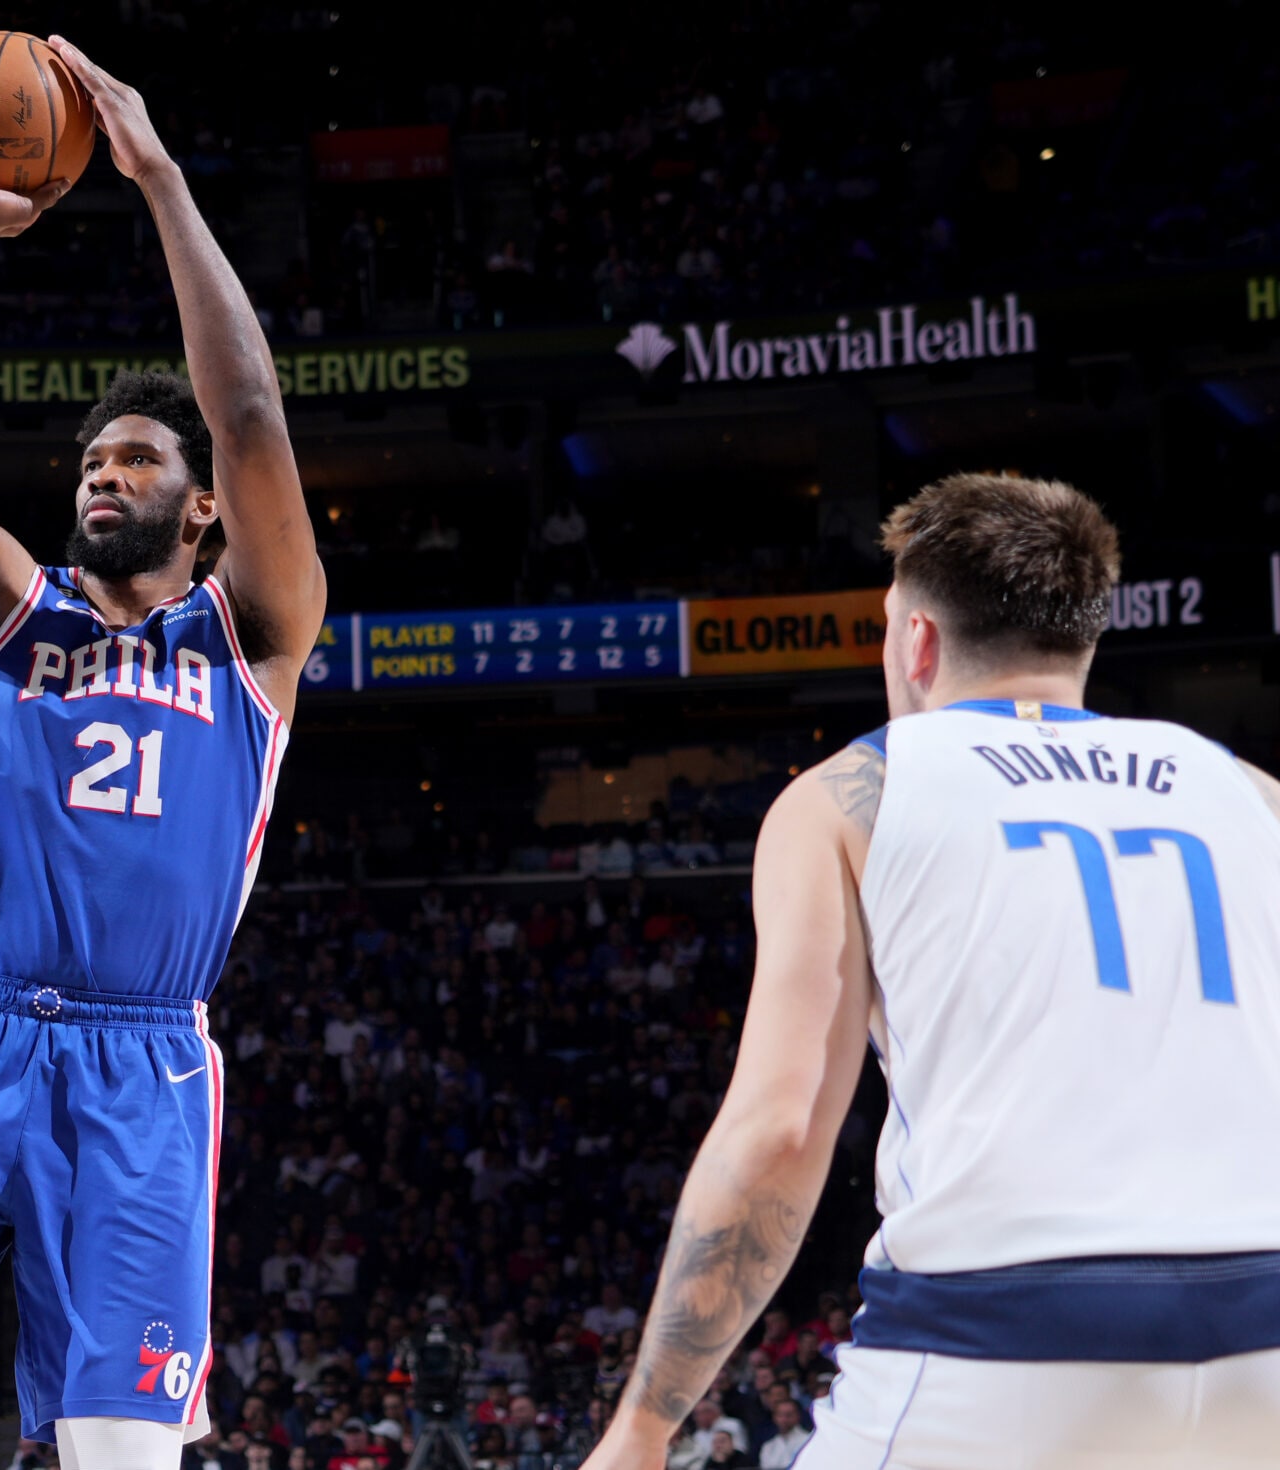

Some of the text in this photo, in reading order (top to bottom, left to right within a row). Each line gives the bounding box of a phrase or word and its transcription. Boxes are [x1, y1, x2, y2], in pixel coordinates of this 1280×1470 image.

[682, 294, 1037, 383] MoraviaHealth
[277, 347, 469, 397] SERVICES
[1179, 576, 1203, 625] 2
[370, 614, 666, 648] PLAYER 11 25 7 2 77
[696, 613, 841, 655] GLORIA
[18, 635, 214, 725] PHILA
[304, 650, 330, 683] 6
[372, 645, 661, 679] POINTS 7 2 2 12 5
[68, 721, 163, 817] 21
[970, 740, 1177, 794] DONČIĆ
[999, 820, 1239, 1008] 77
[135, 1344, 191, 1400] 76
